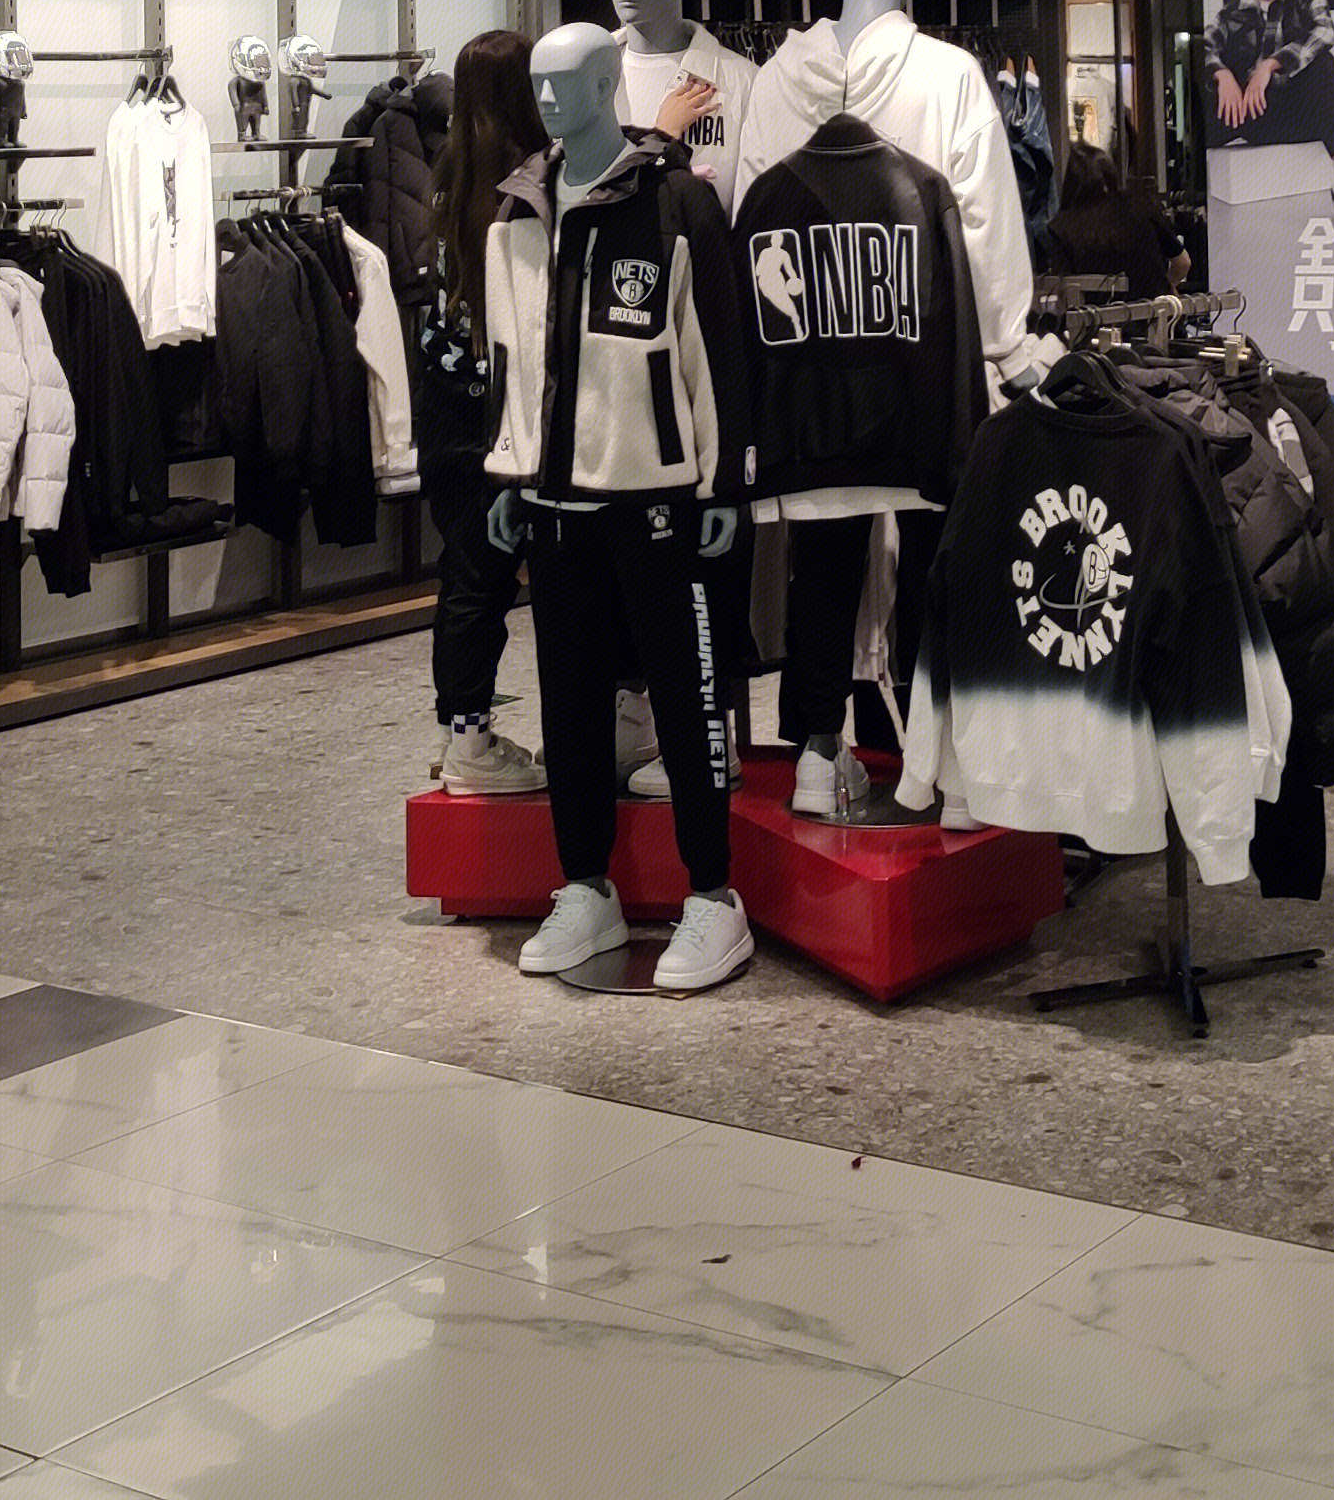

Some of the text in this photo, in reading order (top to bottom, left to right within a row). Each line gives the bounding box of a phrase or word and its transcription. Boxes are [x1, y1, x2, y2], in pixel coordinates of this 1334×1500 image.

[688, 115, 724, 147] NBA
[614, 261, 656, 284] NETS
[808, 222, 920, 343] NBA
[608, 306, 651, 325] BROOKLYN
